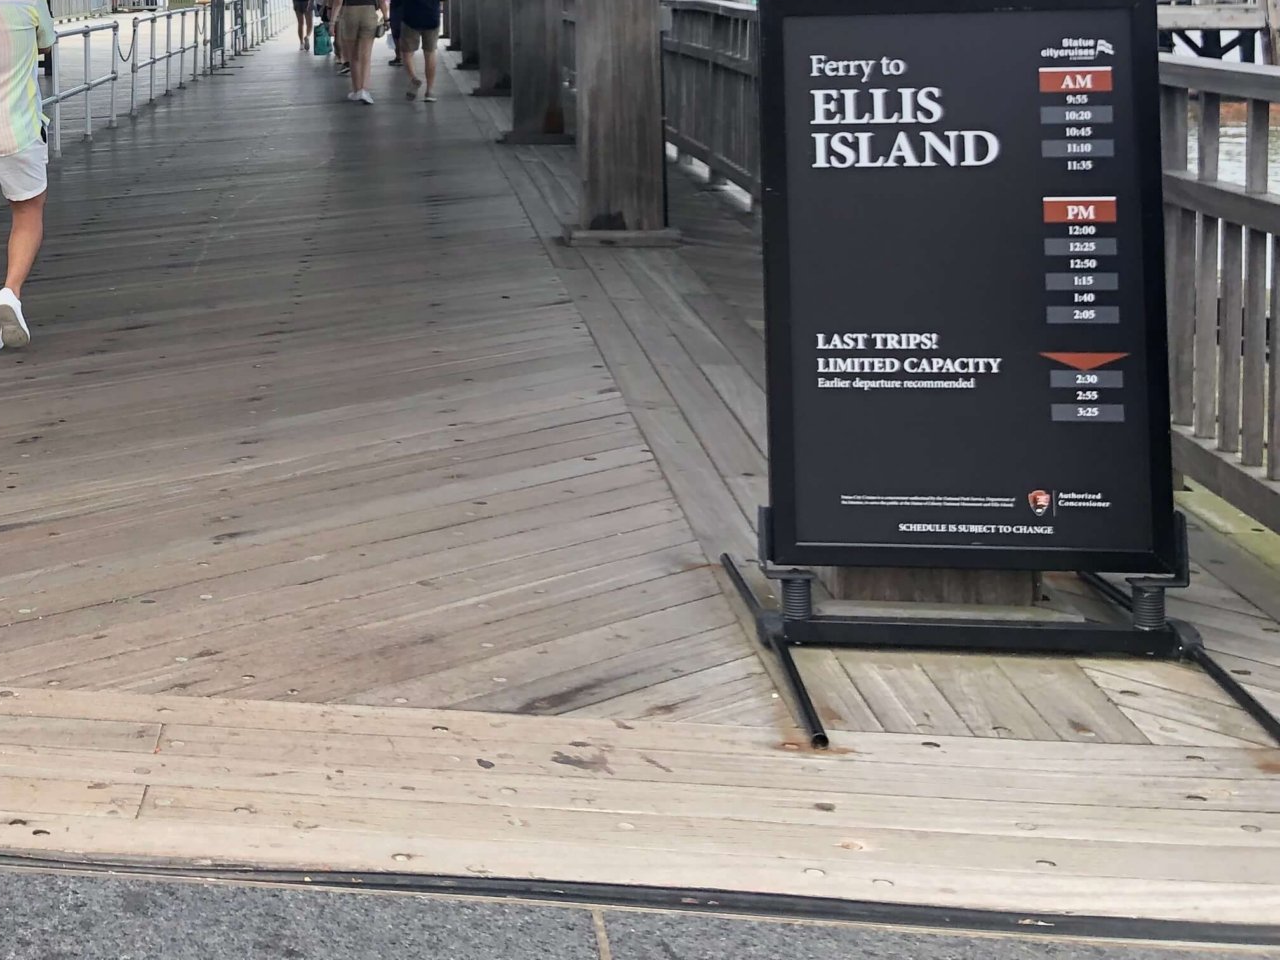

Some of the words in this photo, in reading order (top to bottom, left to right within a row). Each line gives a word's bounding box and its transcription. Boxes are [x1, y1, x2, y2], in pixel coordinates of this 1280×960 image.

[1062, 39, 1095, 47] Statue
[1041, 48, 1095, 58] citycruises
[810, 55, 875, 83] Ferry
[881, 56, 906, 76] to
[1061, 74, 1093, 89] AM
[1066, 95, 1088, 104] 9:55
[810, 87, 943, 125] ELLIS
[1065, 111, 1091, 120] 10:20
[1065, 127, 1092, 137] 10:45
[811, 130, 999, 169] ISLAND
[1067, 143, 1091, 153] 11:10
[1067, 160, 1092, 170] 11:35
[1067, 205, 1095, 220] PM
[1069, 226, 1096, 235] 12:00
[1070, 242, 1096, 252] 12:25
[1070, 259, 1097, 269] 12:50
[1074, 276, 1094, 286] 1:15
[1074, 293, 1096, 303] 1:40
[1073, 310, 1096, 320] 2:05
[816, 333, 868, 351] LAST
[871, 333, 939, 350] TRIPS!
[817, 357, 899, 374] LIMITED
[903, 357, 1002, 374] CAPACITY
[818, 377, 851, 389] Earlier
[852, 378, 902, 391] departure
[903, 377, 975, 389] recommended
[1075, 374, 1098, 384] 2:30
[1076, 391, 1099, 401] 2:55
[1076, 408, 1099, 417] 3:25
[1058, 500, 1111, 508] Concessioner
[898, 523, 947, 533] SCHEDULE
[948, 524, 957, 533] IS
[958, 524, 996, 534] SUBJECT
[997, 525, 1011, 534] TO
[1012, 525, 1054, 535] CHANGE
